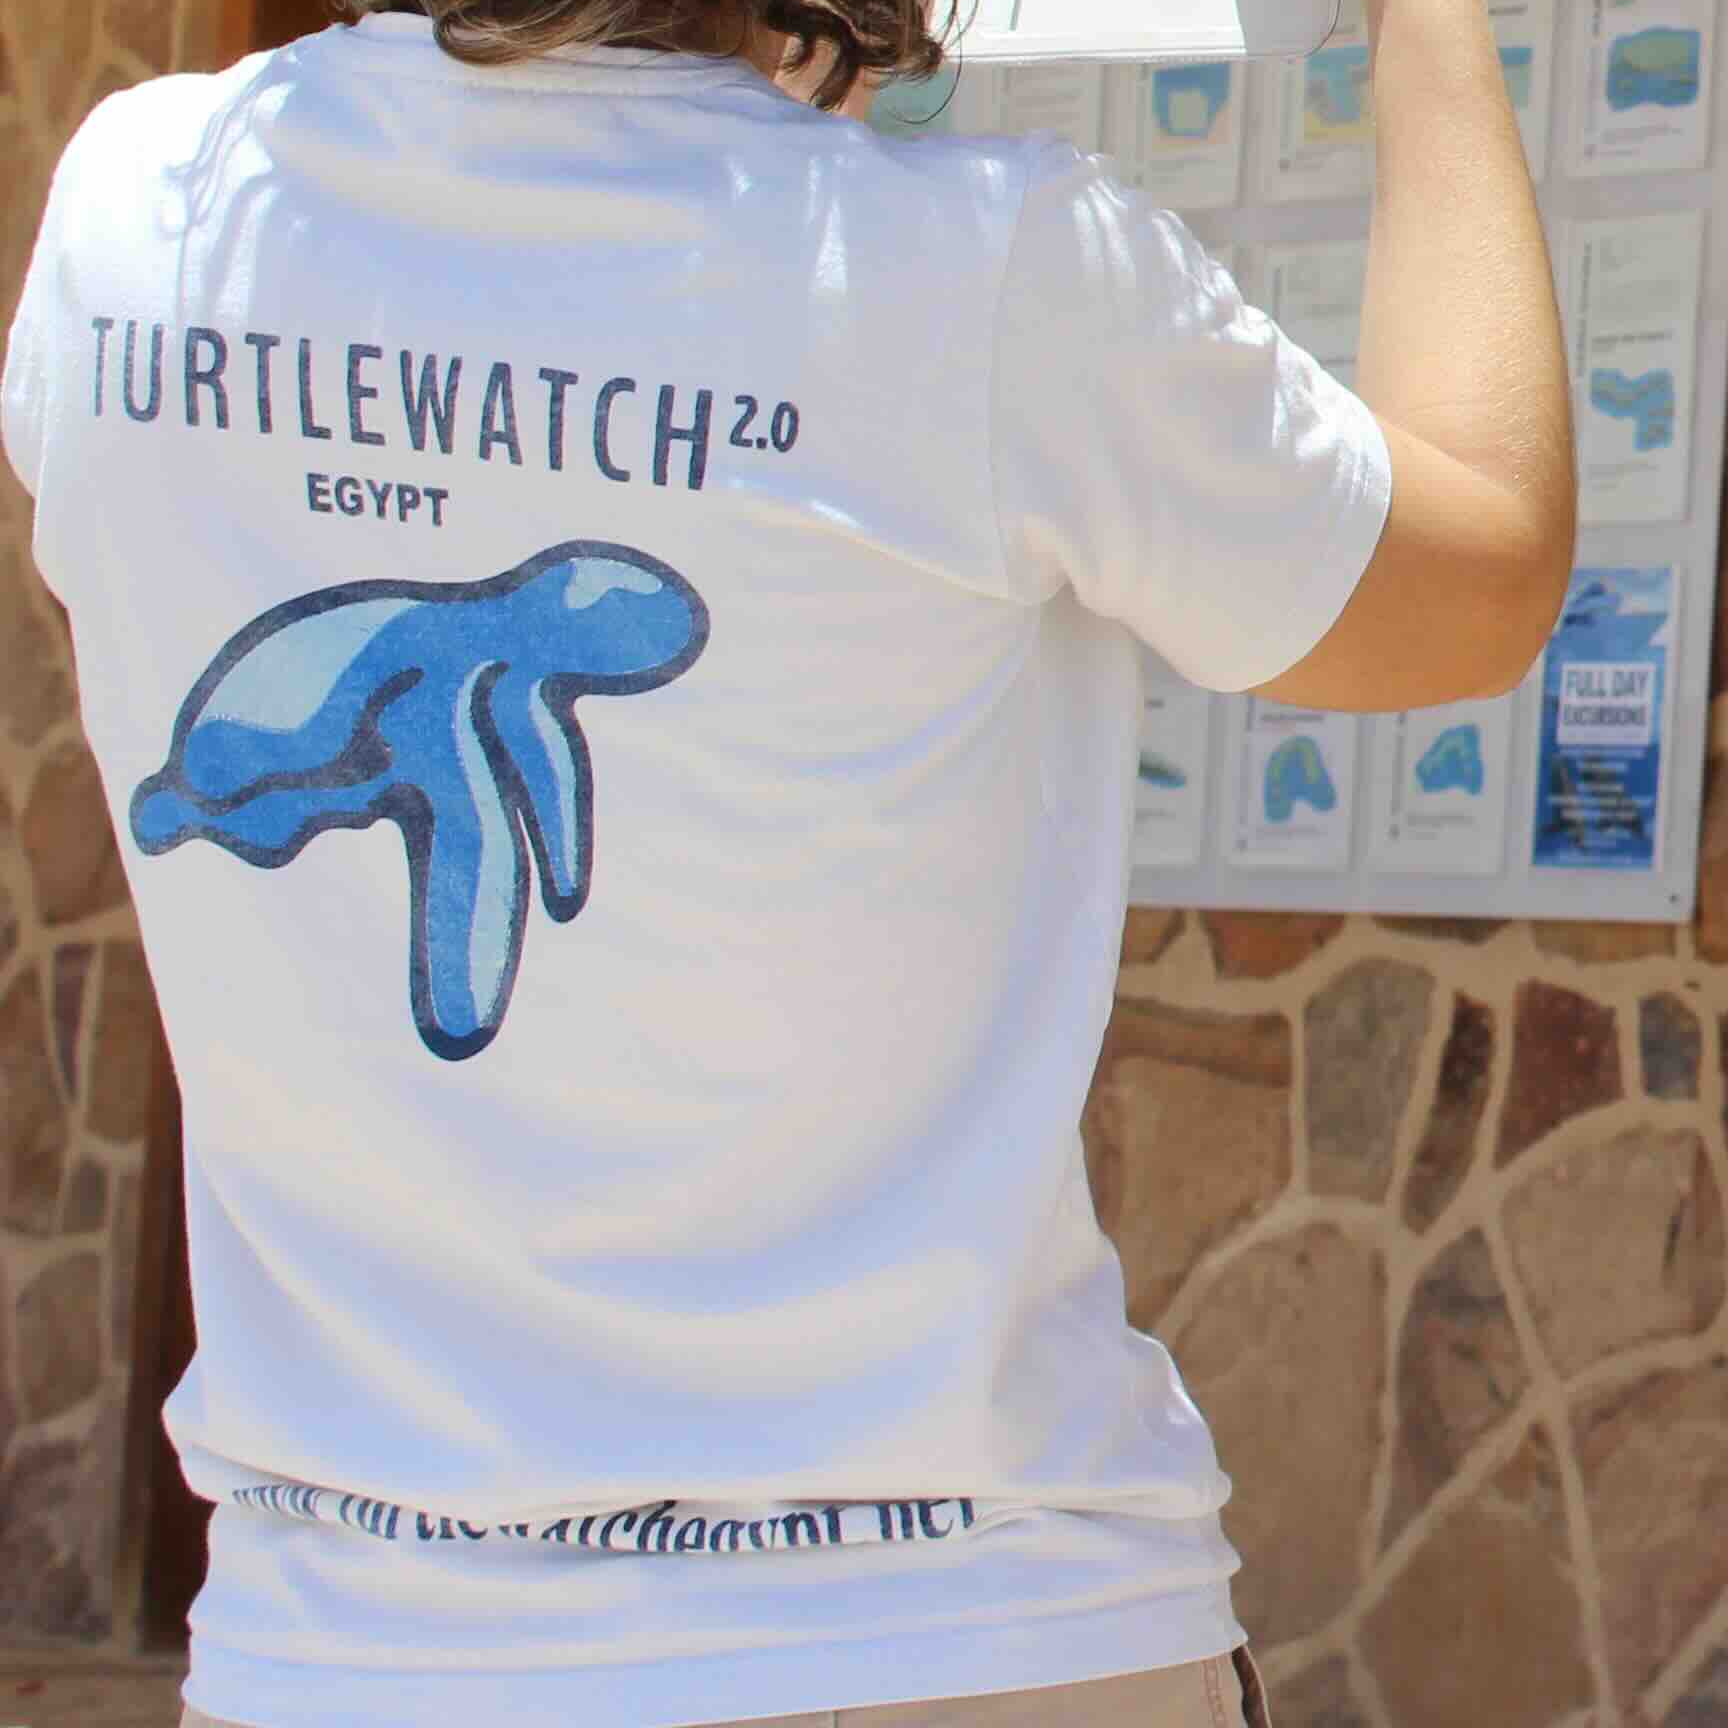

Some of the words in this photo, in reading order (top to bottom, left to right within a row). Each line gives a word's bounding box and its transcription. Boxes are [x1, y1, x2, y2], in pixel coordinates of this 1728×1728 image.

[91, 317, 713, 491] TURTLEWATCH
[729, 394, 800, 453] 2.0
[306, 472, 450, 527] EGYPT
[1566, 671, 1606, 697] FULL
[1611, 670, 1649, 697] DAY
